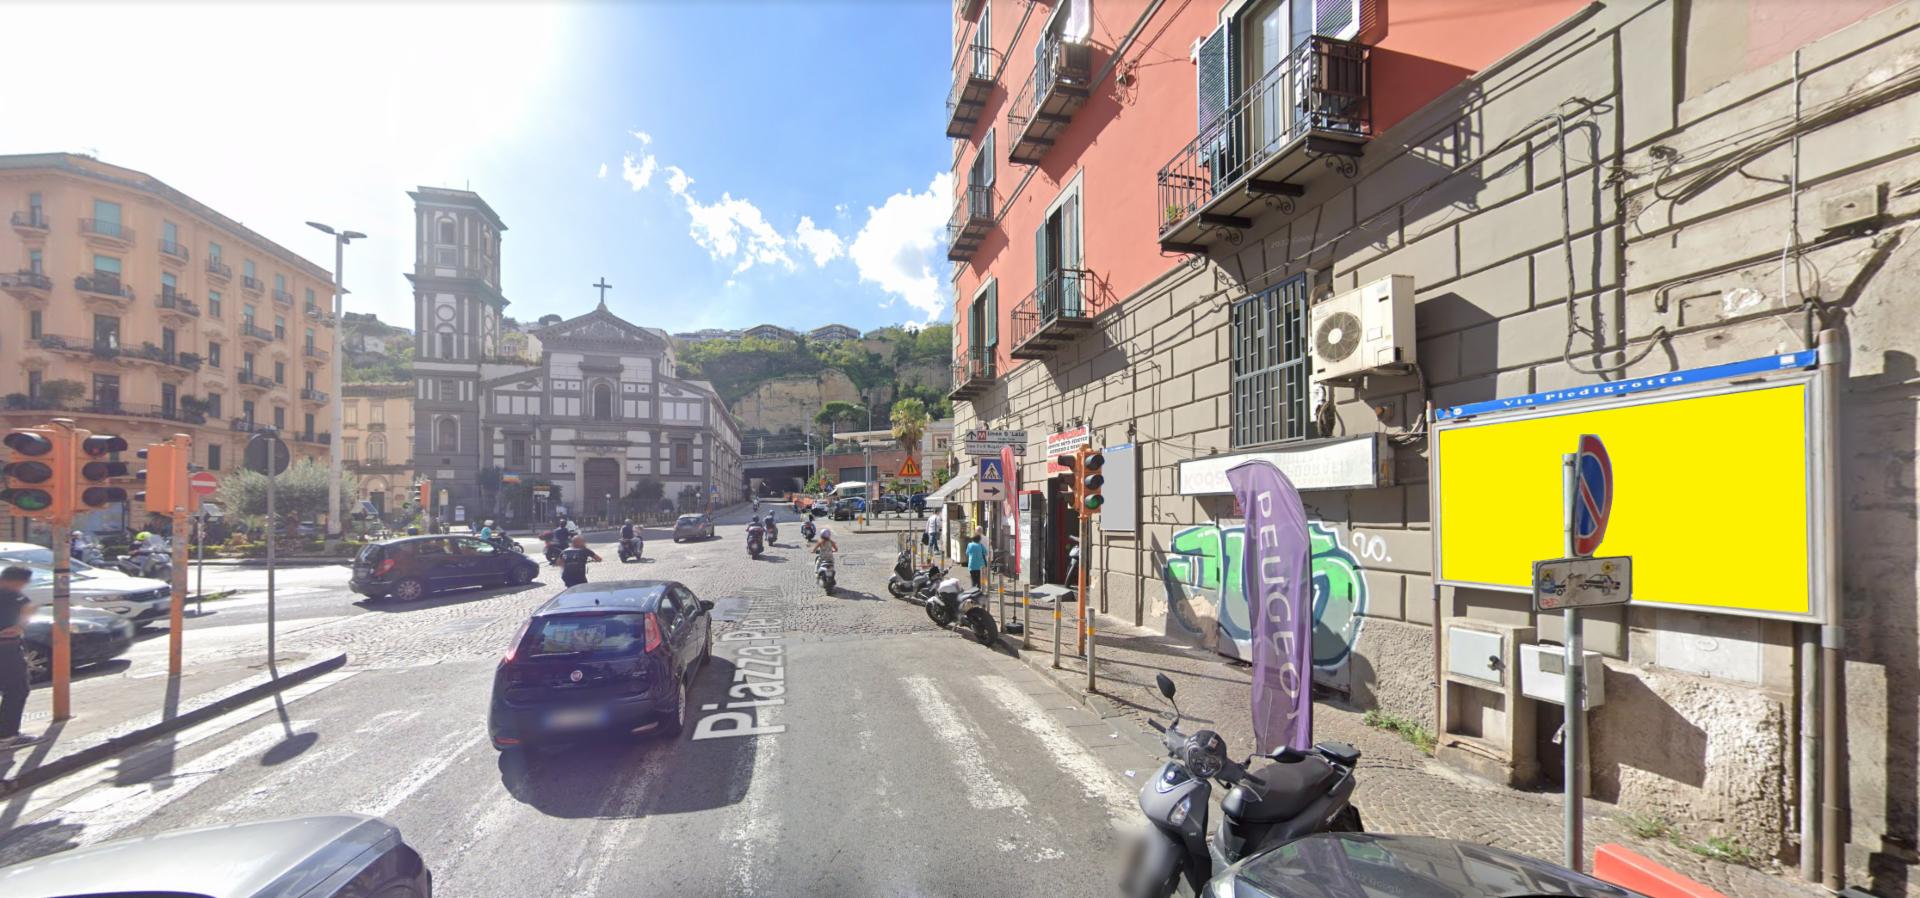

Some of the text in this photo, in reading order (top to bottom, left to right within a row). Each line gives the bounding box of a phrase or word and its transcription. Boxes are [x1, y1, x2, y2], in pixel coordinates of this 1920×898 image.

[1503, 375, 1684, 407] Via Piedigrotta
[1258, 491, 1300, 720] PEUGEO
